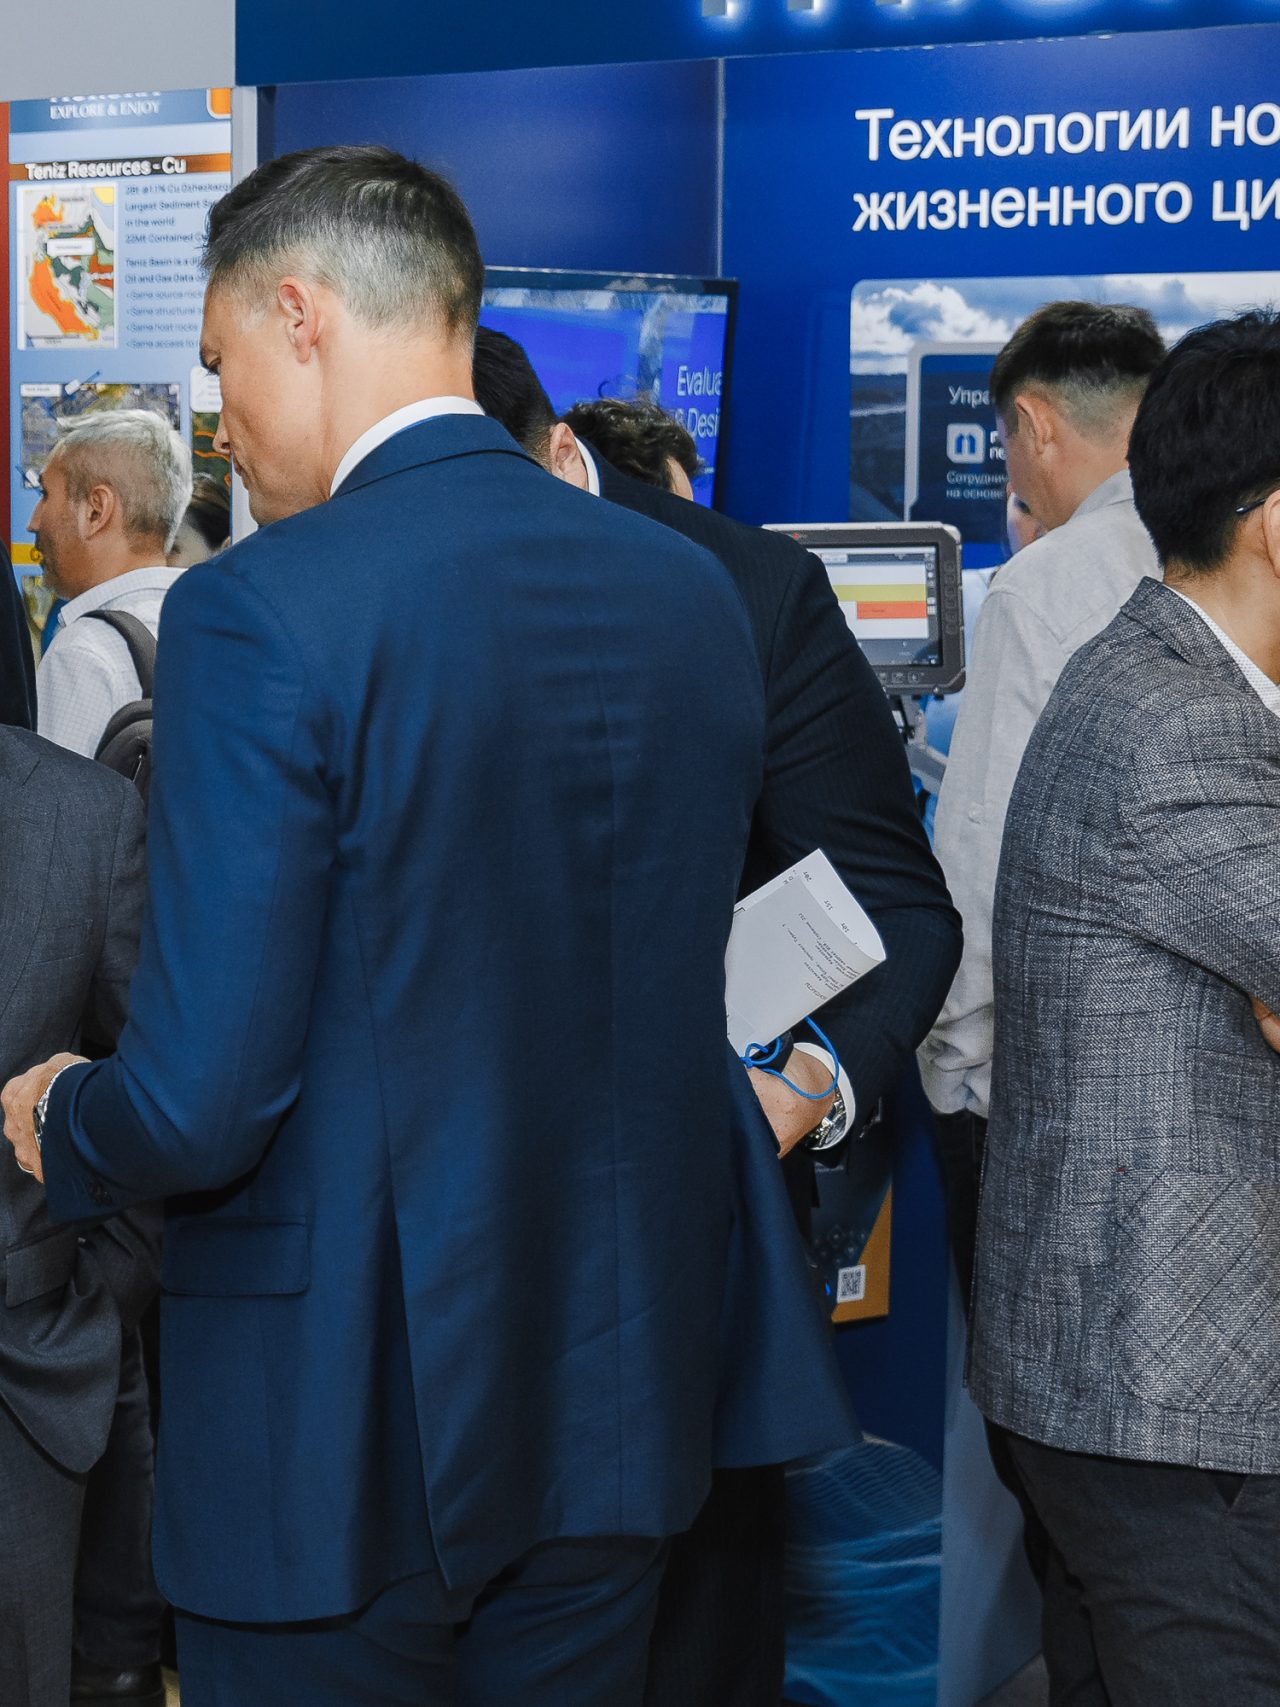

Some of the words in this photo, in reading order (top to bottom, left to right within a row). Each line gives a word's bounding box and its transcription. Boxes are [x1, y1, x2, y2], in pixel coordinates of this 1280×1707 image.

[50, 102, 106, 120] EXPLORE
[120, 101, 161, 116] ENJOY
[854, 107, 1190, 162] Технологии
[1211, 102, 1280, 147] но
[25, 161, 68, 181] Teniz
[68, 158, 151, 179] Resources
[161, 156, 187, 174] Cu
[851, 180, 1193, 232] жизненного
[1212, 178, 1280, 232] ци
